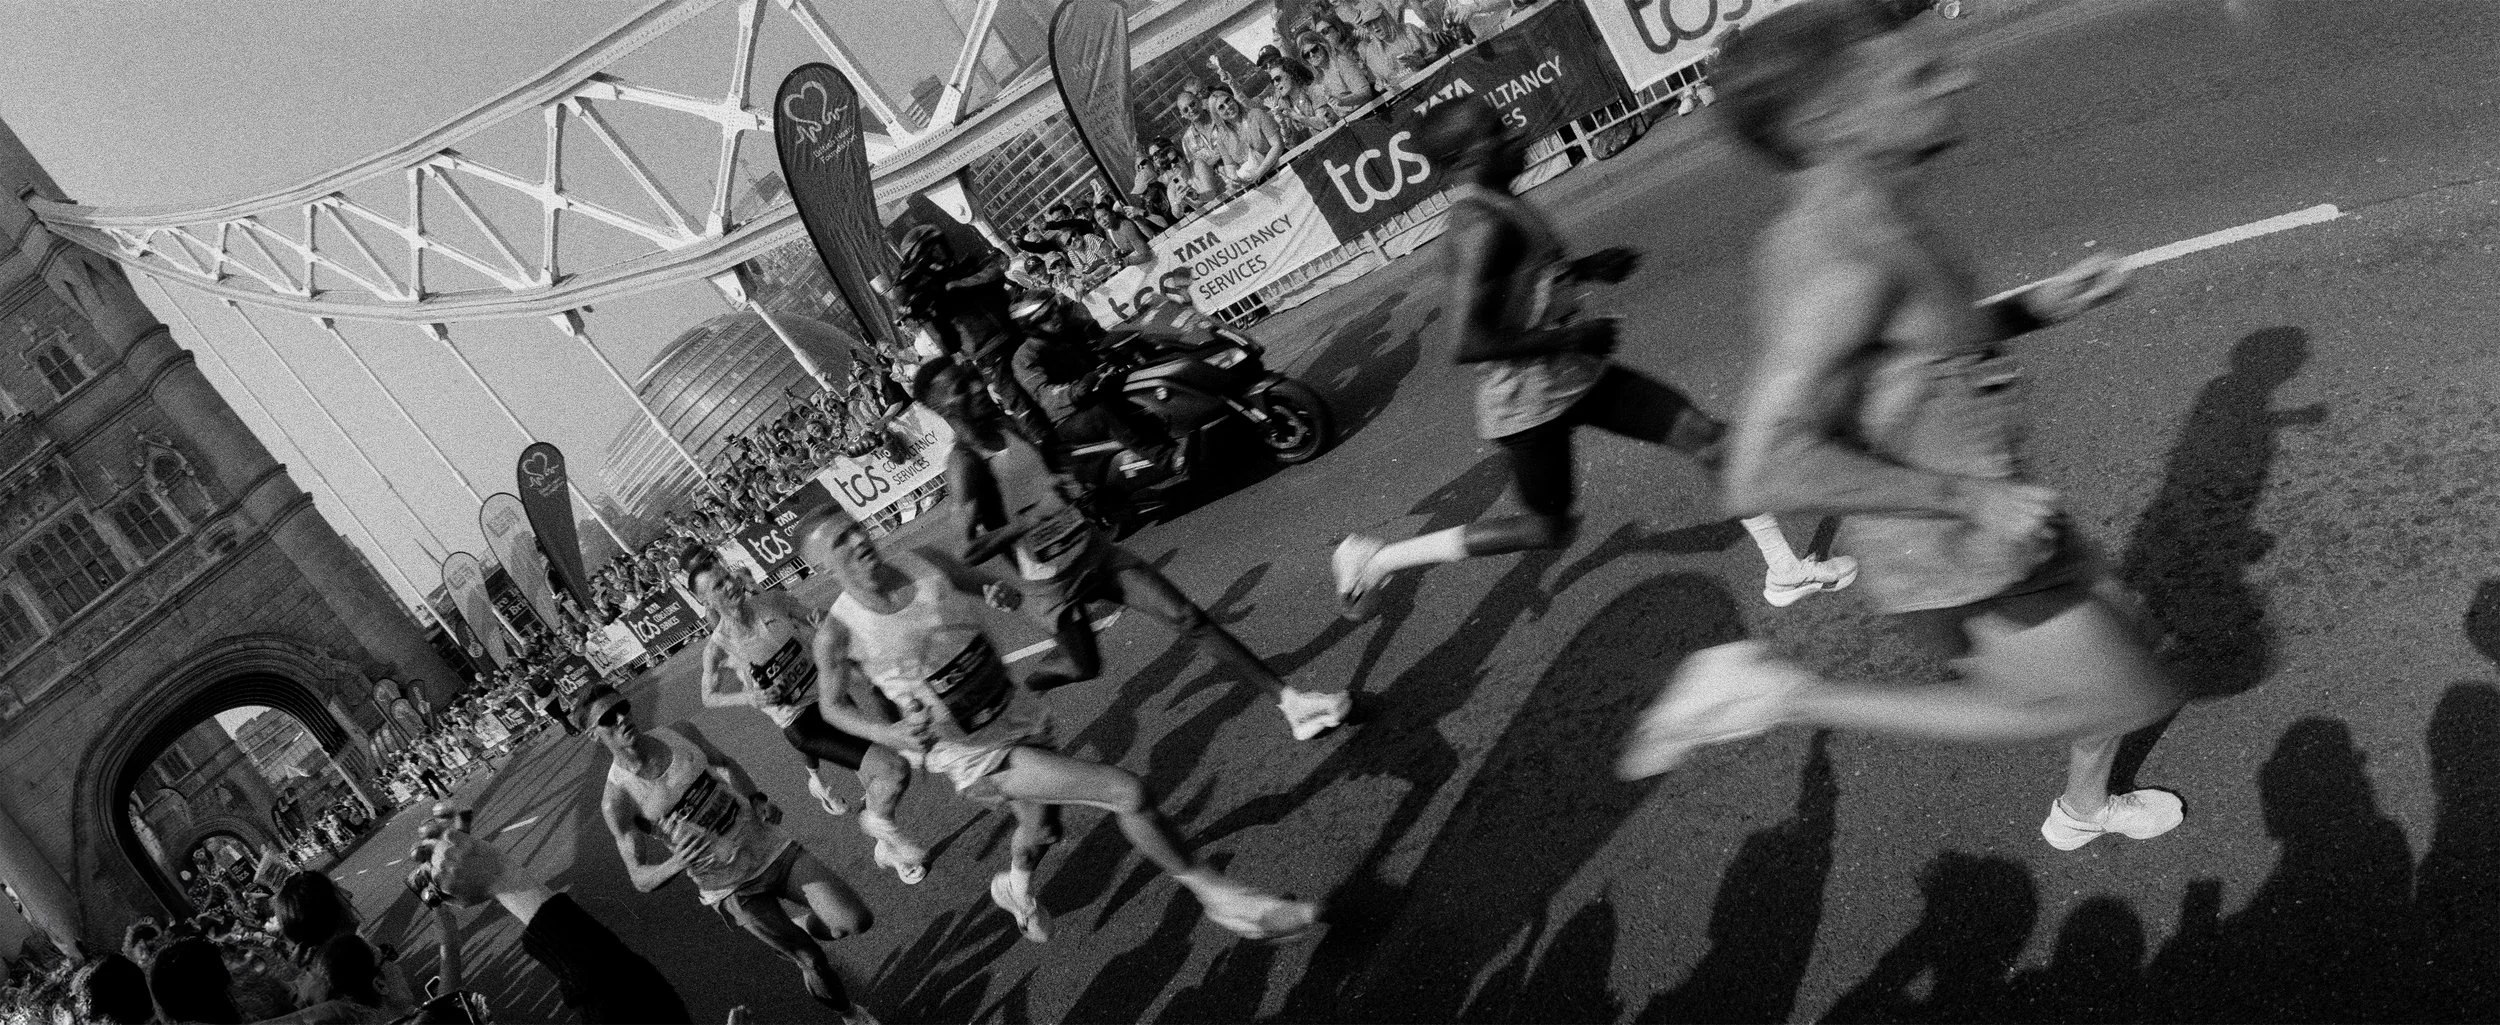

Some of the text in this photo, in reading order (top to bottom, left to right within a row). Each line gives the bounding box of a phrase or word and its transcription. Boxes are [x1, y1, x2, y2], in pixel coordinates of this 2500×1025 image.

[1323, 130, 1431, 213] tcs
[1173, 231, 1221, 263] TATA
[1188, 214, 1293, 281] CONSULTANCY
[1199, 254, 1268, 300] SERVICES
[833, 465, 891, 508] tcs
[892, 457, 930, 486] SERVICES
[774, 510, 798, 527] TATA
[747, 528, 793, 564] tcs
[628, 615, 661, 643] tcs
